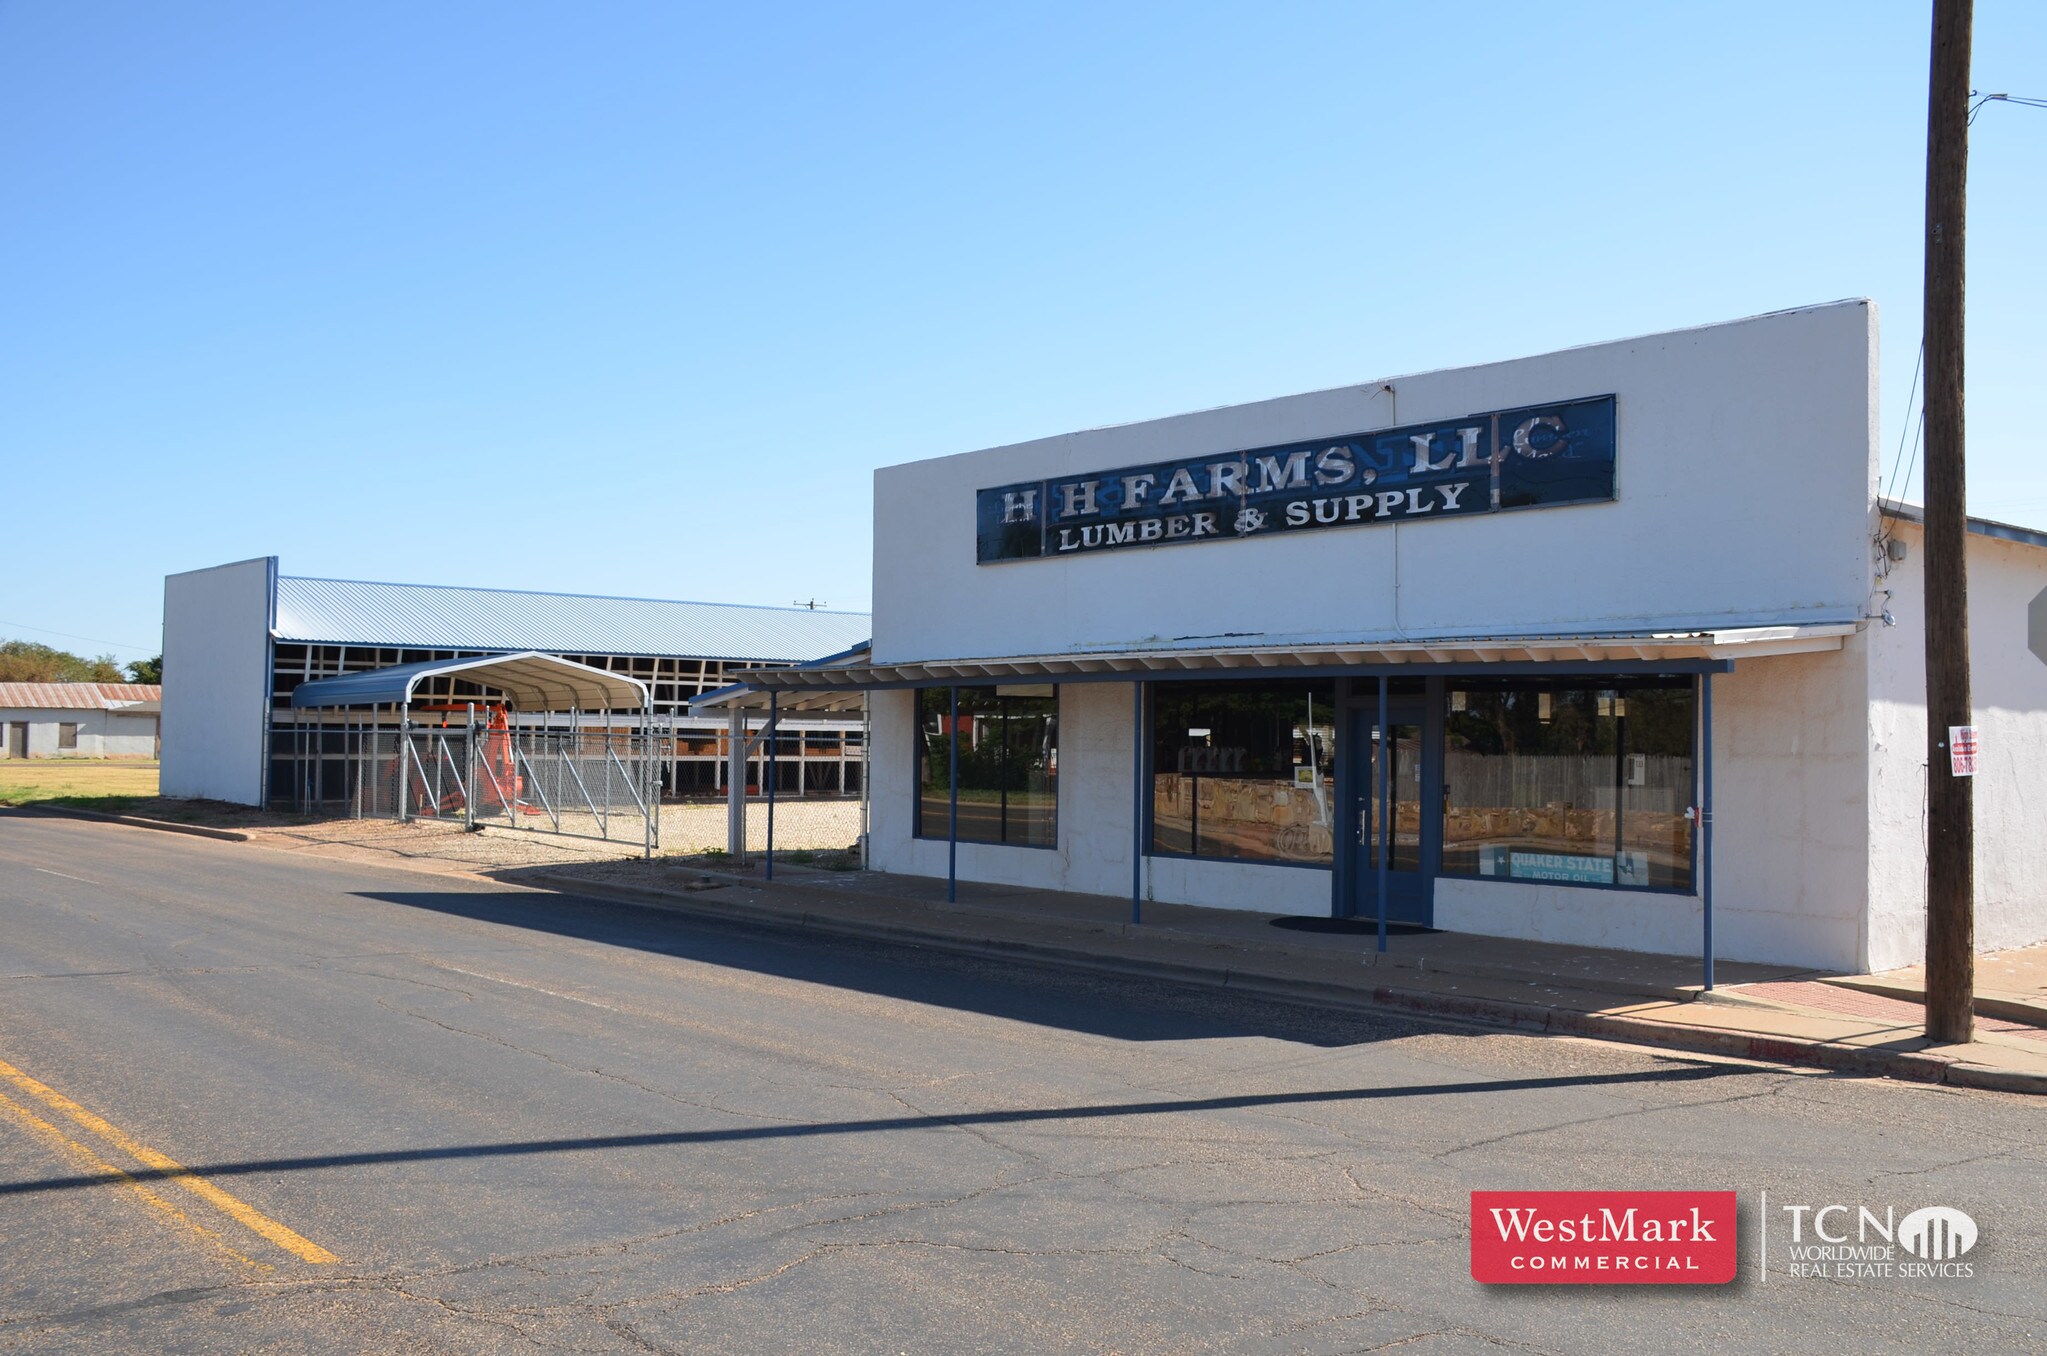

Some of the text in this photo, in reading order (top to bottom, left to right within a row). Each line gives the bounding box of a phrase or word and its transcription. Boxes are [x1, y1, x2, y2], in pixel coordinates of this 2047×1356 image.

[1001, 415, 1567, 523] H H FARMS, LLC
[1059, 482, 1470, 551] LUMBER & SUPPLY
[1511, 852, 1611, 872] QUAKER STATE
[1532, 870, 1590, 882] MOTOR OIL
